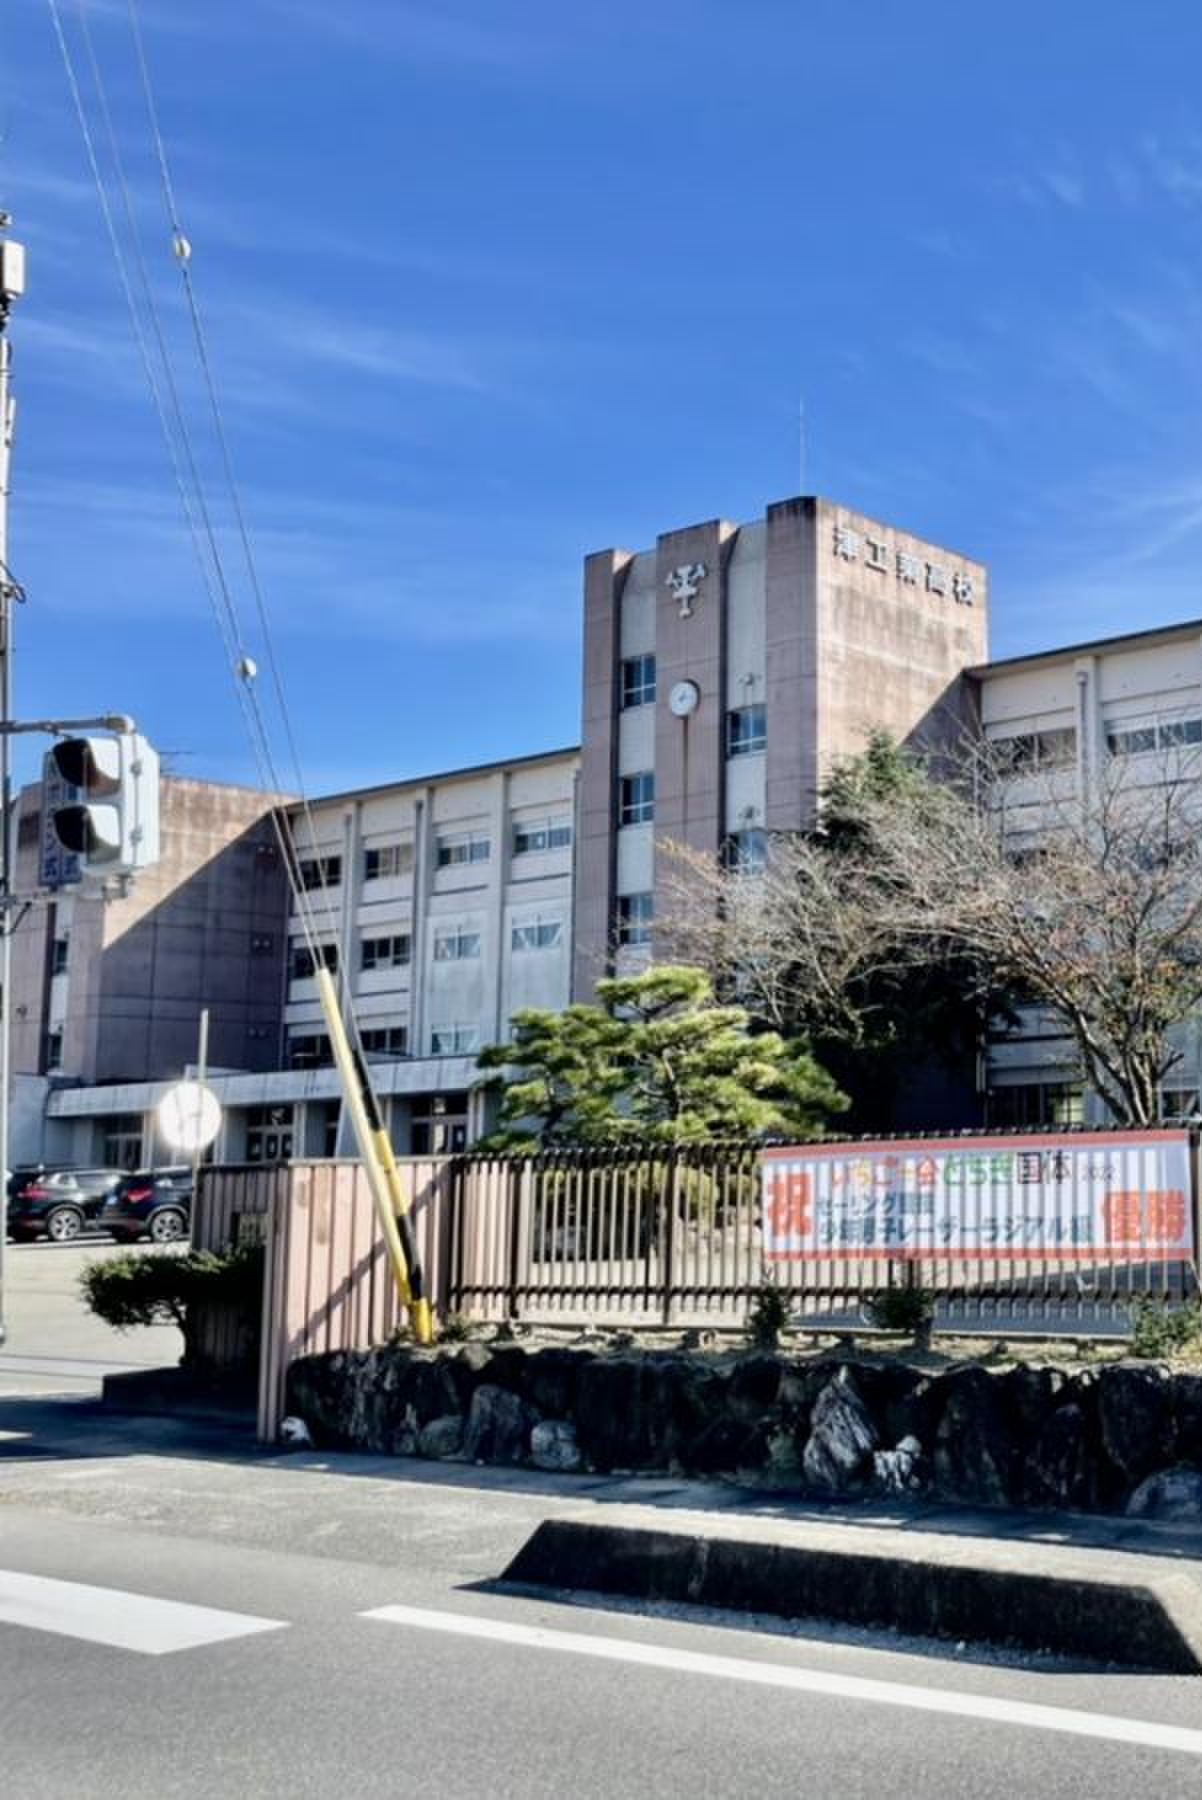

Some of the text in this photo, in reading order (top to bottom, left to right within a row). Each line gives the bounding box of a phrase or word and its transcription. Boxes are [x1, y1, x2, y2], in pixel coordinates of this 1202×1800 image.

[767, 1172, 812, 1238] 祝
[816, 1191, 936, 1217] セーリング
[1099, 1190, 1185, 1244] 優勝
